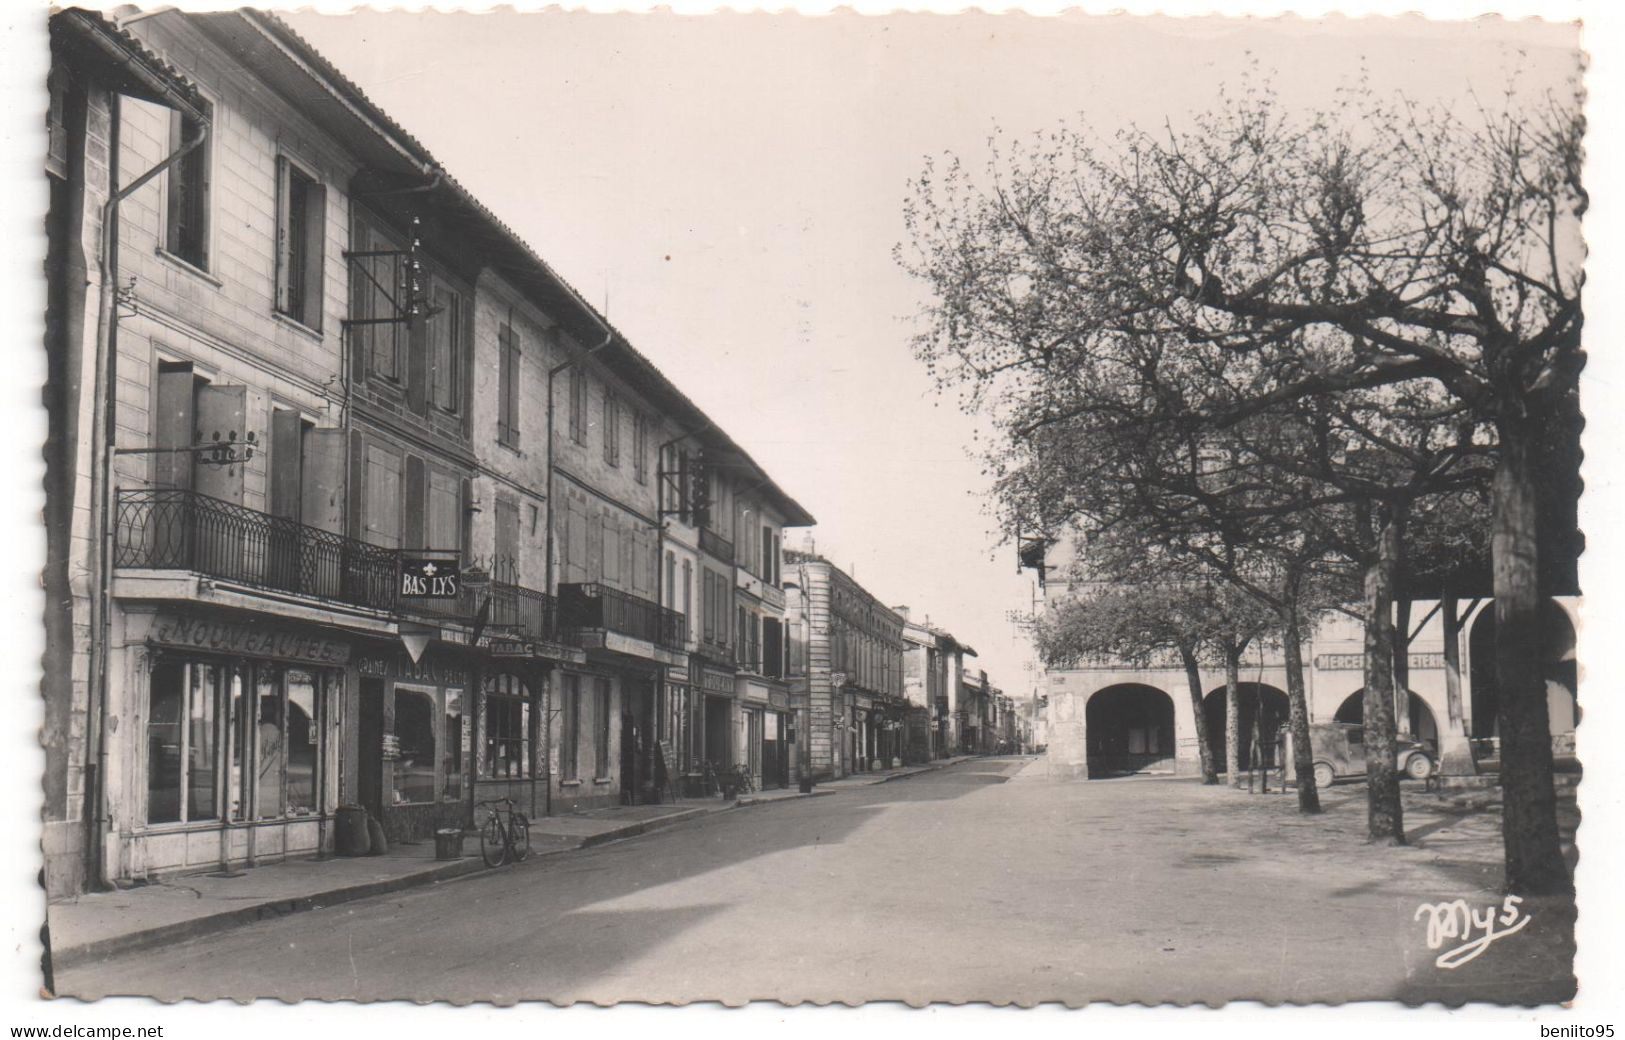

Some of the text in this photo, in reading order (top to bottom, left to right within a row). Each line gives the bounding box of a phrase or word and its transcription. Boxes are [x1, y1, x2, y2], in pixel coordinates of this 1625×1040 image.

[402, 573, 426, 595] BAS
[432, 575, 456, 595] LYS
[490, 643, 533, 653] TABAC
[1319, 655, 1364, 668] MERCE
